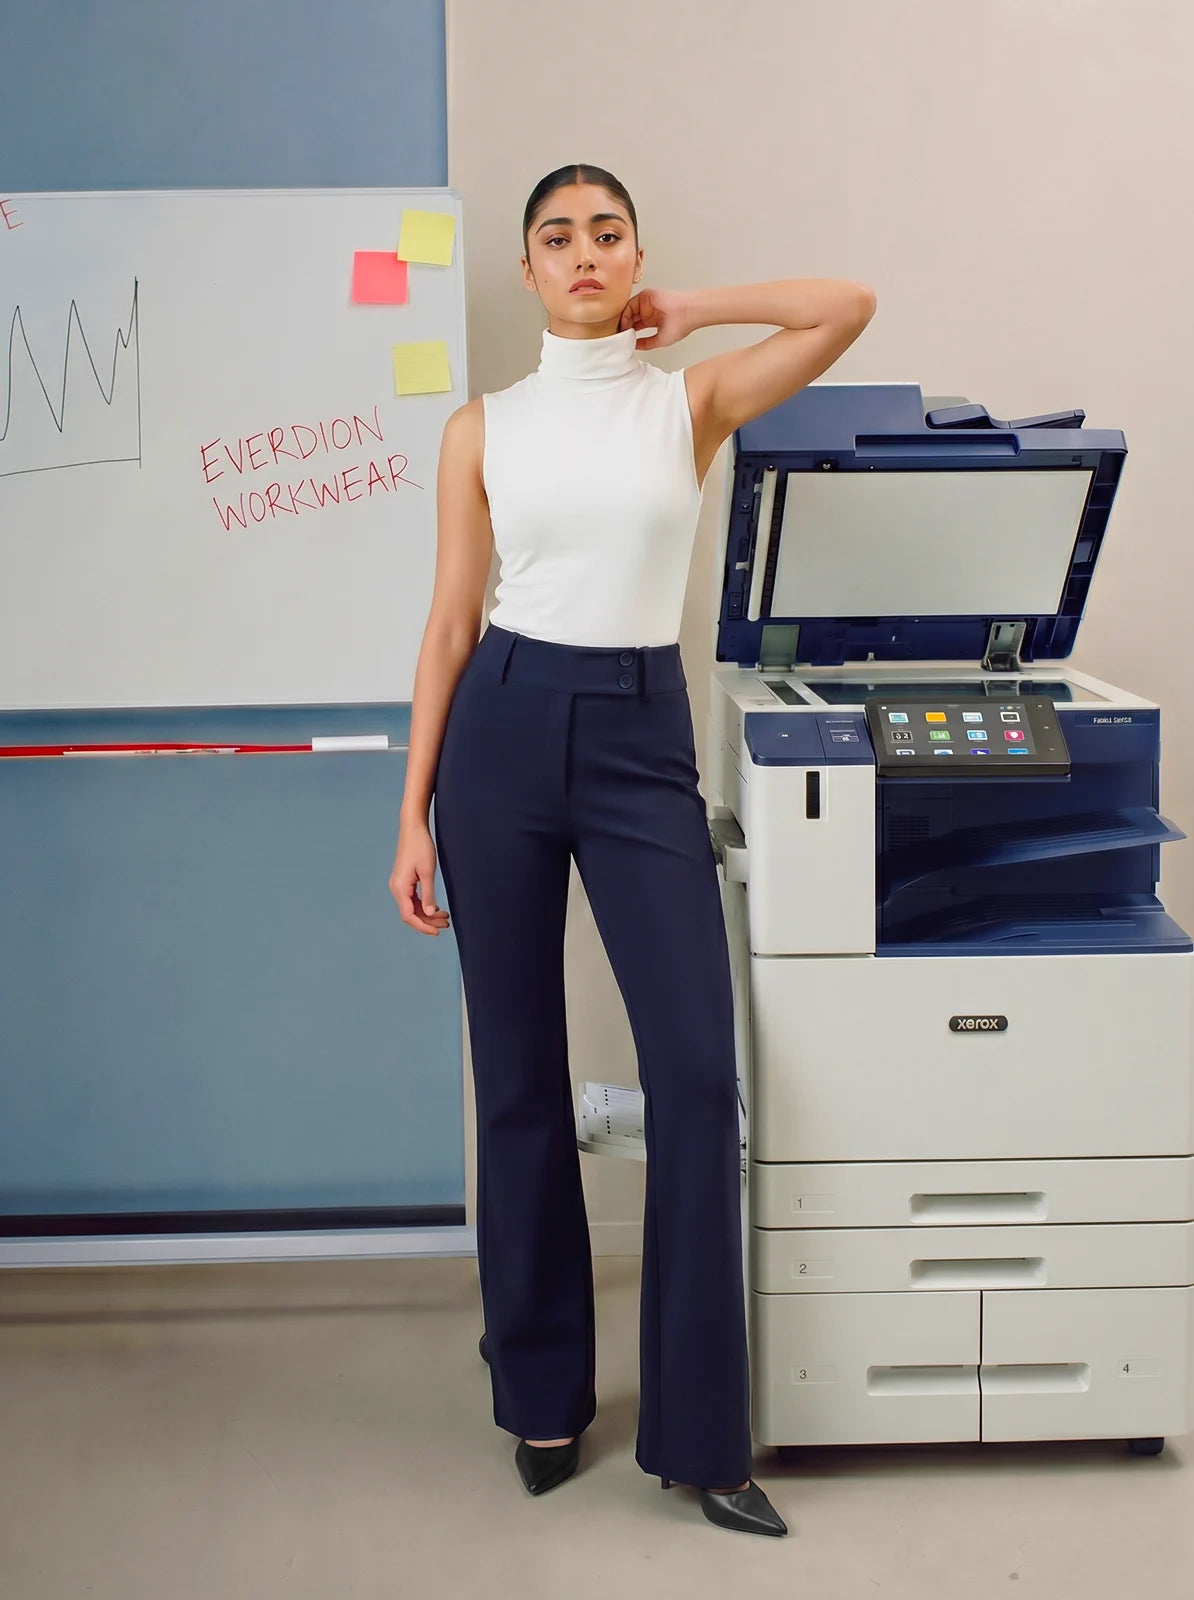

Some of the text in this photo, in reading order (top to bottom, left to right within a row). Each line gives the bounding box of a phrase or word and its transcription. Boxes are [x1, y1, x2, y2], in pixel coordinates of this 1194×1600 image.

[200, 405, 384, 484] EVERDION
[212, 454, 425, 531] WORKWEAR
[957, 1018, 998, 1030] xerox
[797, 1198, 802, 1209] 1
[799, 1263, 807, 1274] 2
[1122, 1363, 1130, 1374] 4
[799, 1369, 807, 1380] 3
